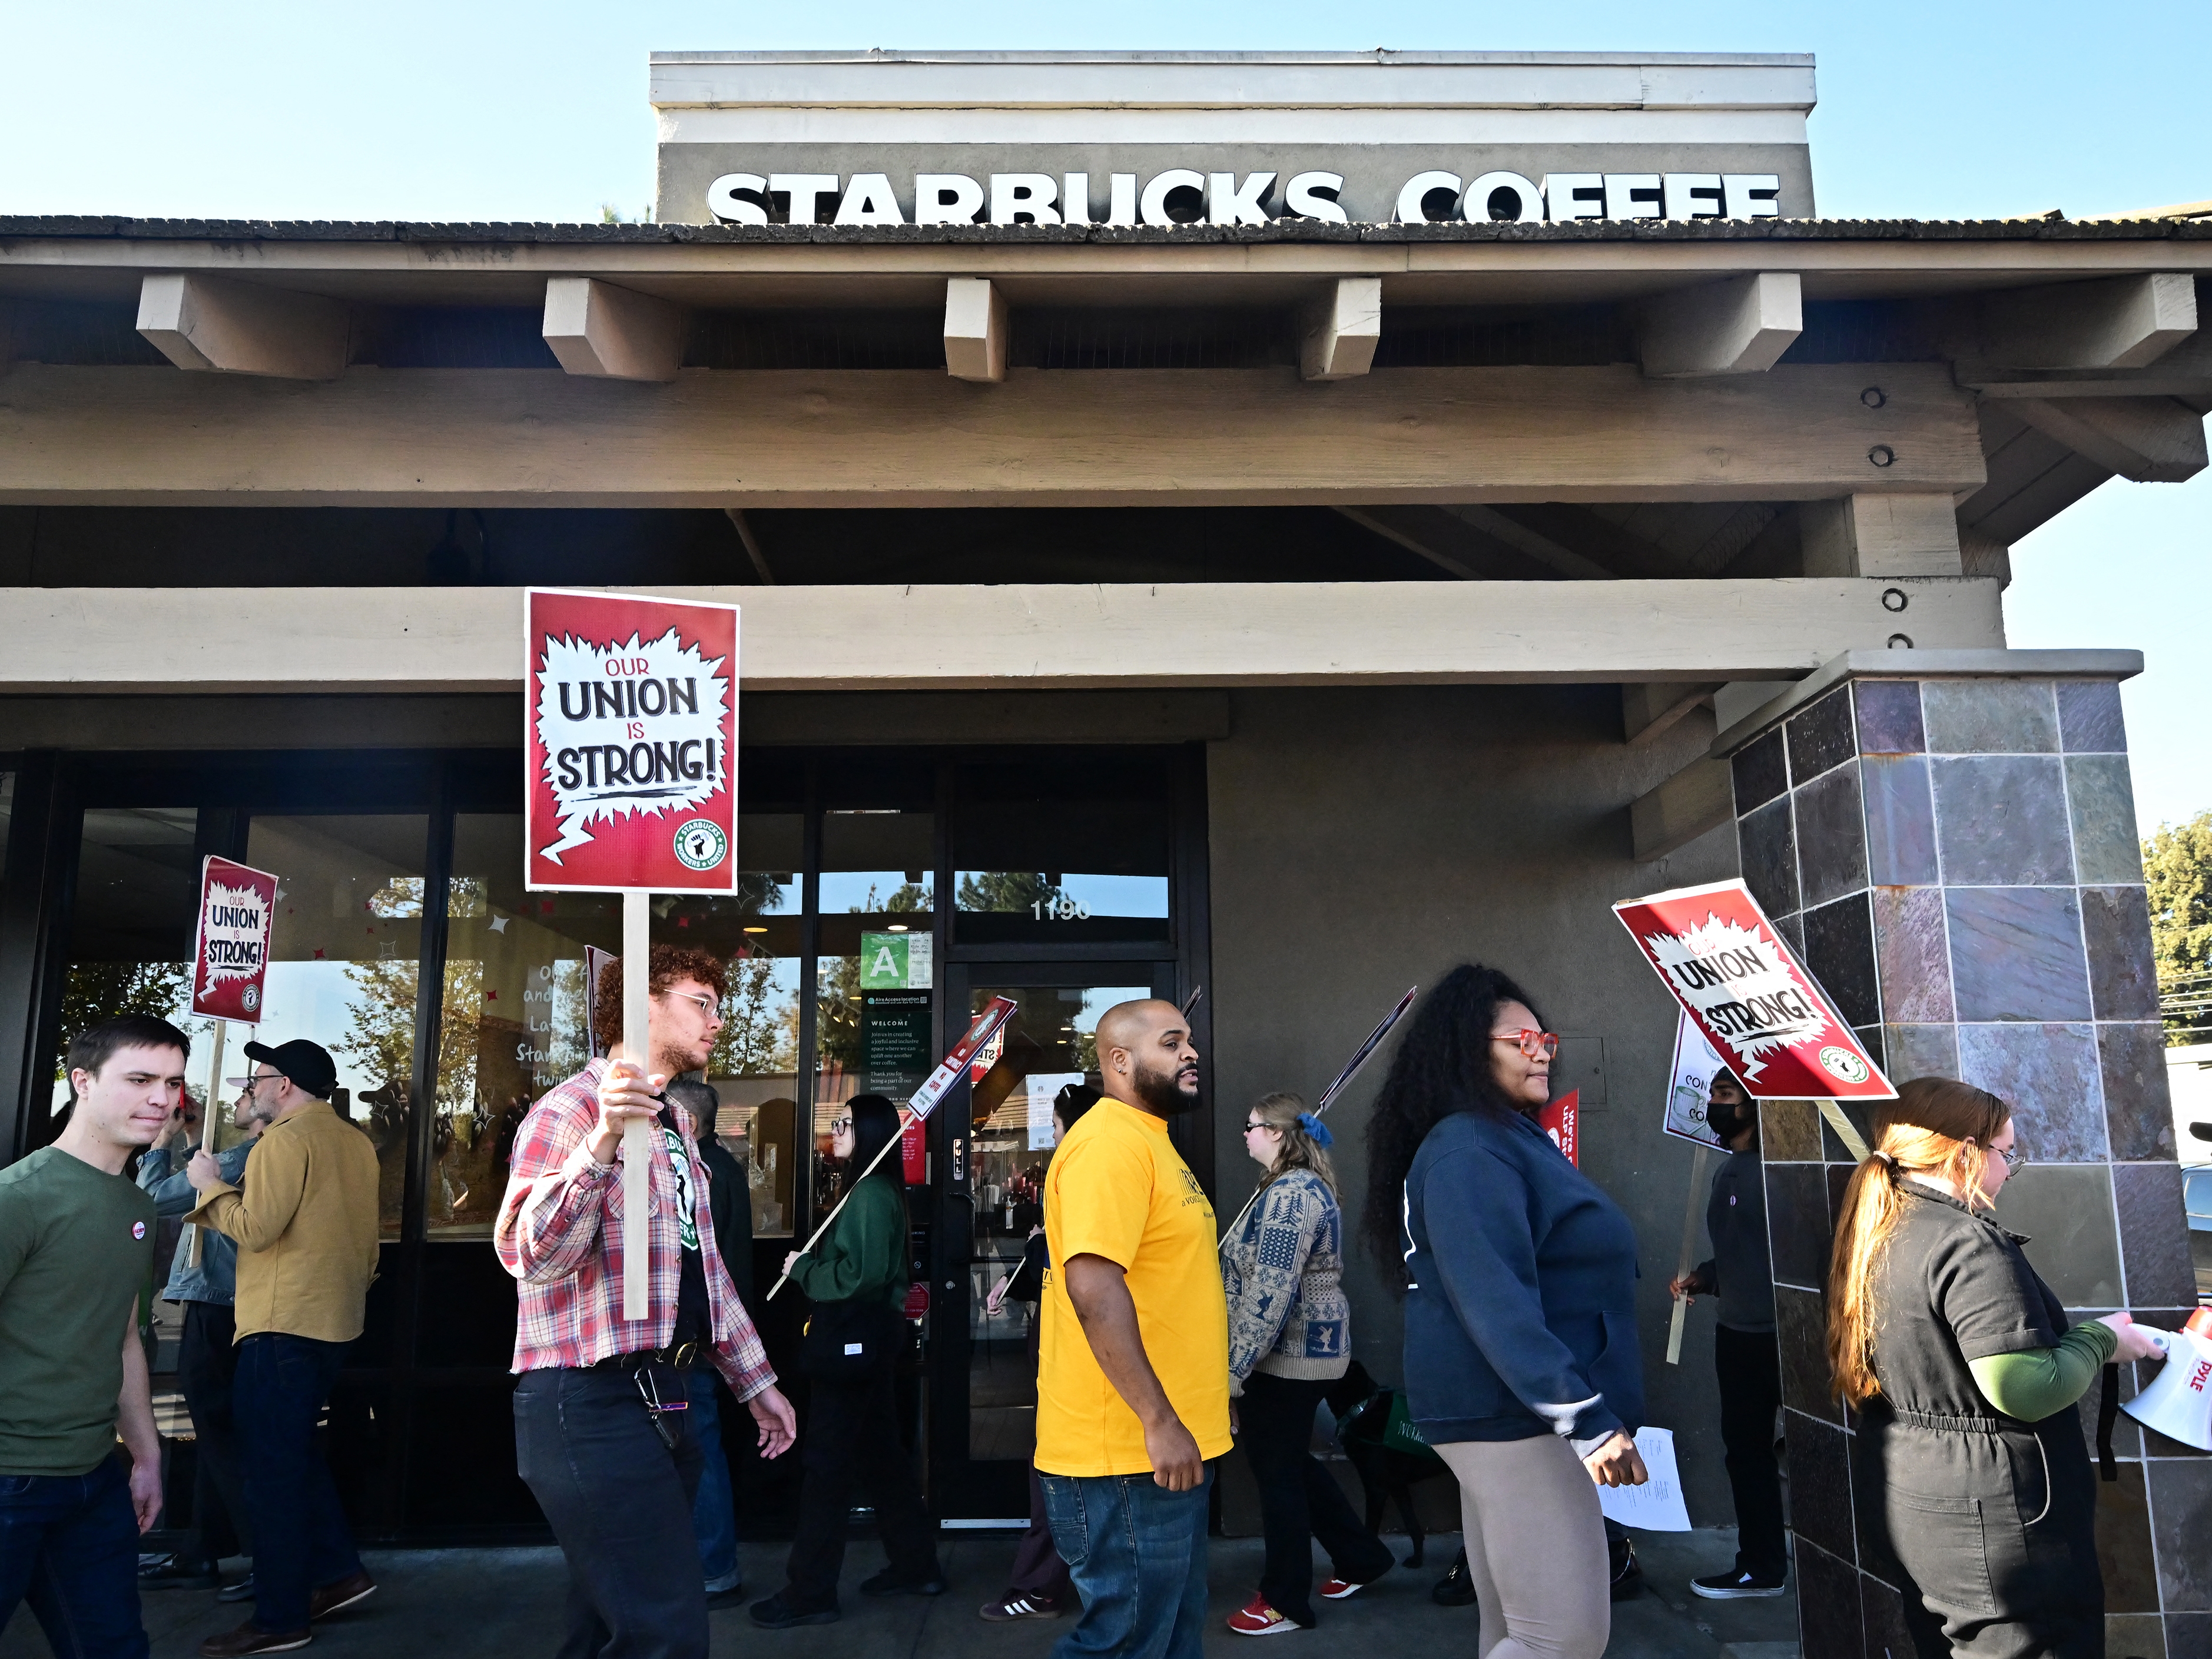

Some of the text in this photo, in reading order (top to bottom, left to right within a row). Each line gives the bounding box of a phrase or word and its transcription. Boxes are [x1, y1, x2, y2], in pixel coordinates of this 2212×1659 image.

[707, 169, 1780, 225] STARBUCKS COFFEE
[605, 658, 649, 676] OUR
[558, 677, 699, 722] UNION
[627, 722, 645, 739] IS
[557, 738, 716, 791] STRONG!
[681, 822, 721, 837] STARBUCKS
[677, 842, 701, 867] WORKERS
[707, 844, 724, 865] UNITED
[230, 896, 244, 906] OUR
[1030, 900, 1091, 920] 1190
[213, 905, 259, 929] UNION
[234, 930, 240, 939] IS
[208, 940, 262, 965] STRONG!
[1688, 938, 1716, 955] OUR
[870, 946, 899, 977] A
[1673, 945, 1770, 990] UNION
[523, 984, 553, 1002] and
[1730, 984, 1747, 997] IS
[1706, 988, 1818, 1036] STRONG!
[1686, 1074, 1710, 1090] CON
[1689, 1108, 1707, 1122] CO
[2190, 1361, 2212, 1393] PYLE
